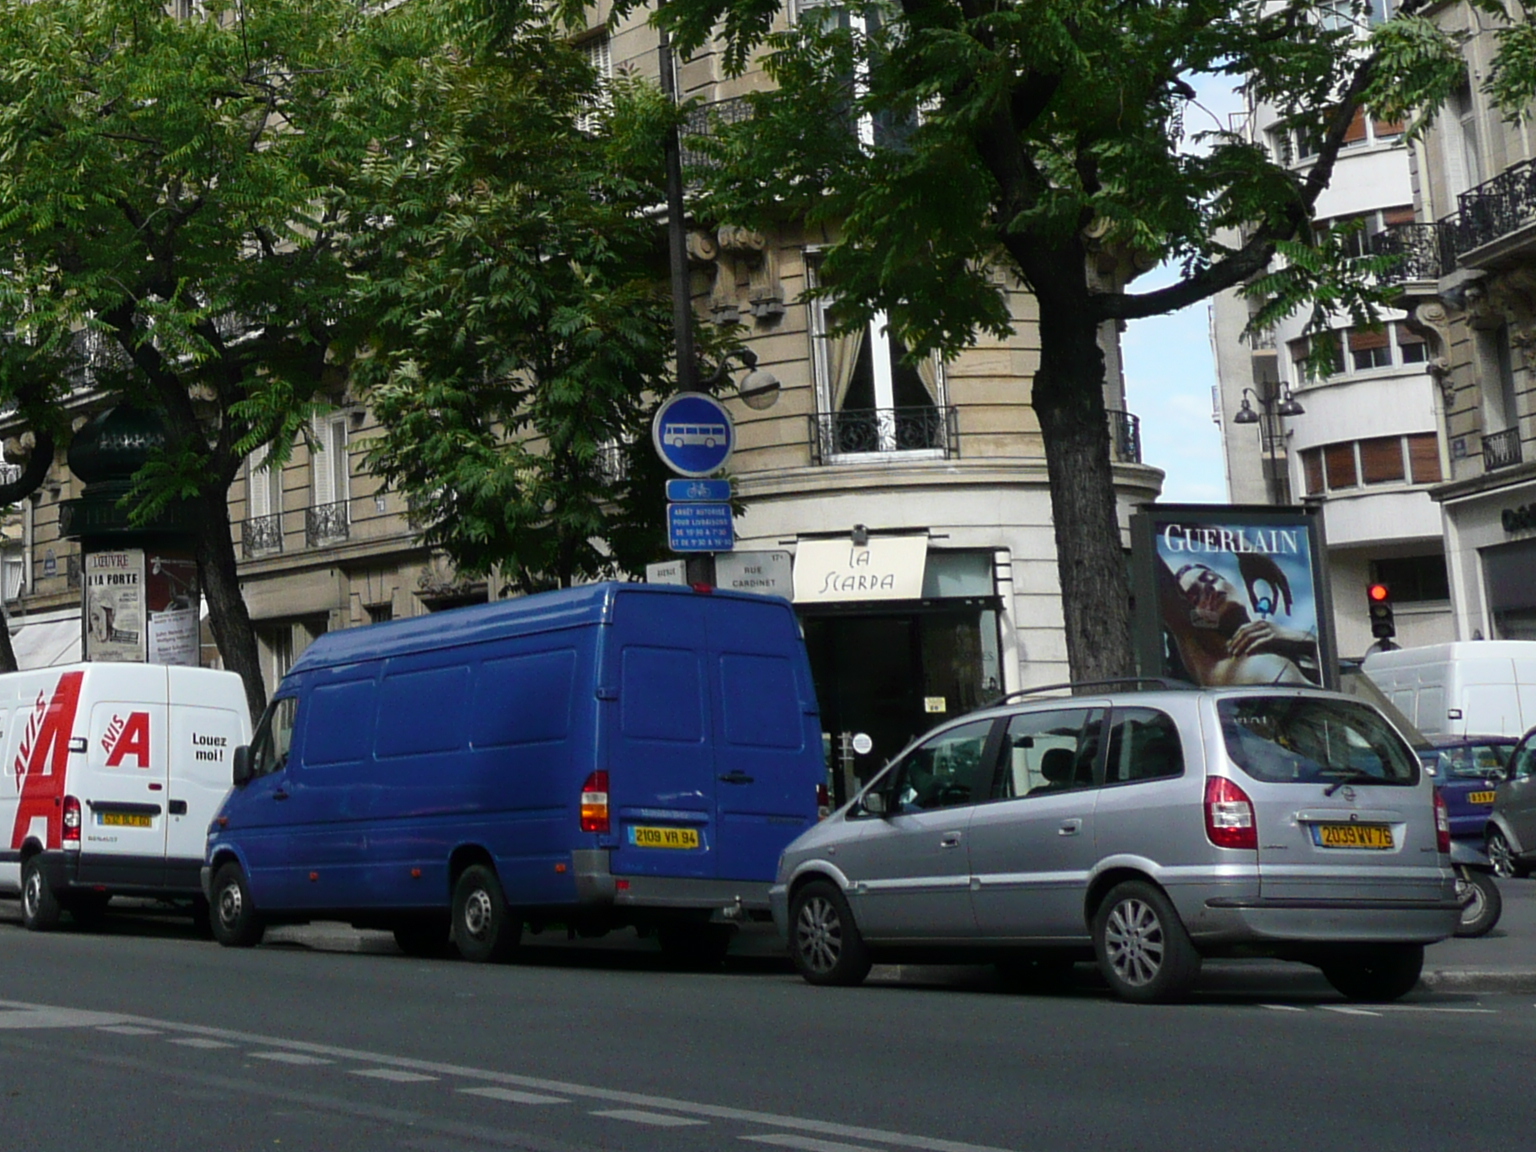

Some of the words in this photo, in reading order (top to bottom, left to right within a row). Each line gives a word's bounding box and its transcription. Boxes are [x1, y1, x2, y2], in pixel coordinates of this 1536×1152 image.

[1164, 523, 1298, 554] GUERLAIN
[849, 547, 870, 568] LA
[107, 573, 138, 585] PORTE
[657, 567, 677, 577] AVENUE
[744, 566, 763, 575] RUE
[732, 579, 776, 587] CARDINET
[818, 570, 895, 594] SCARPA
[13, 689, 46, 794] AVIS
[100, 713, 124, 754] AVIS
[105, 711, 150, 768] A
[192, 732, 228, 747] Louez
[635, 828, 662, 843] 2109
[664, 830, 678, 843] VR
[681, 830, 696, 844] 94
[1322, 825, 1358, 846] 2039
[1357, 824, 1373, 844] WV
[1377, 826, 1393, 844] 76
